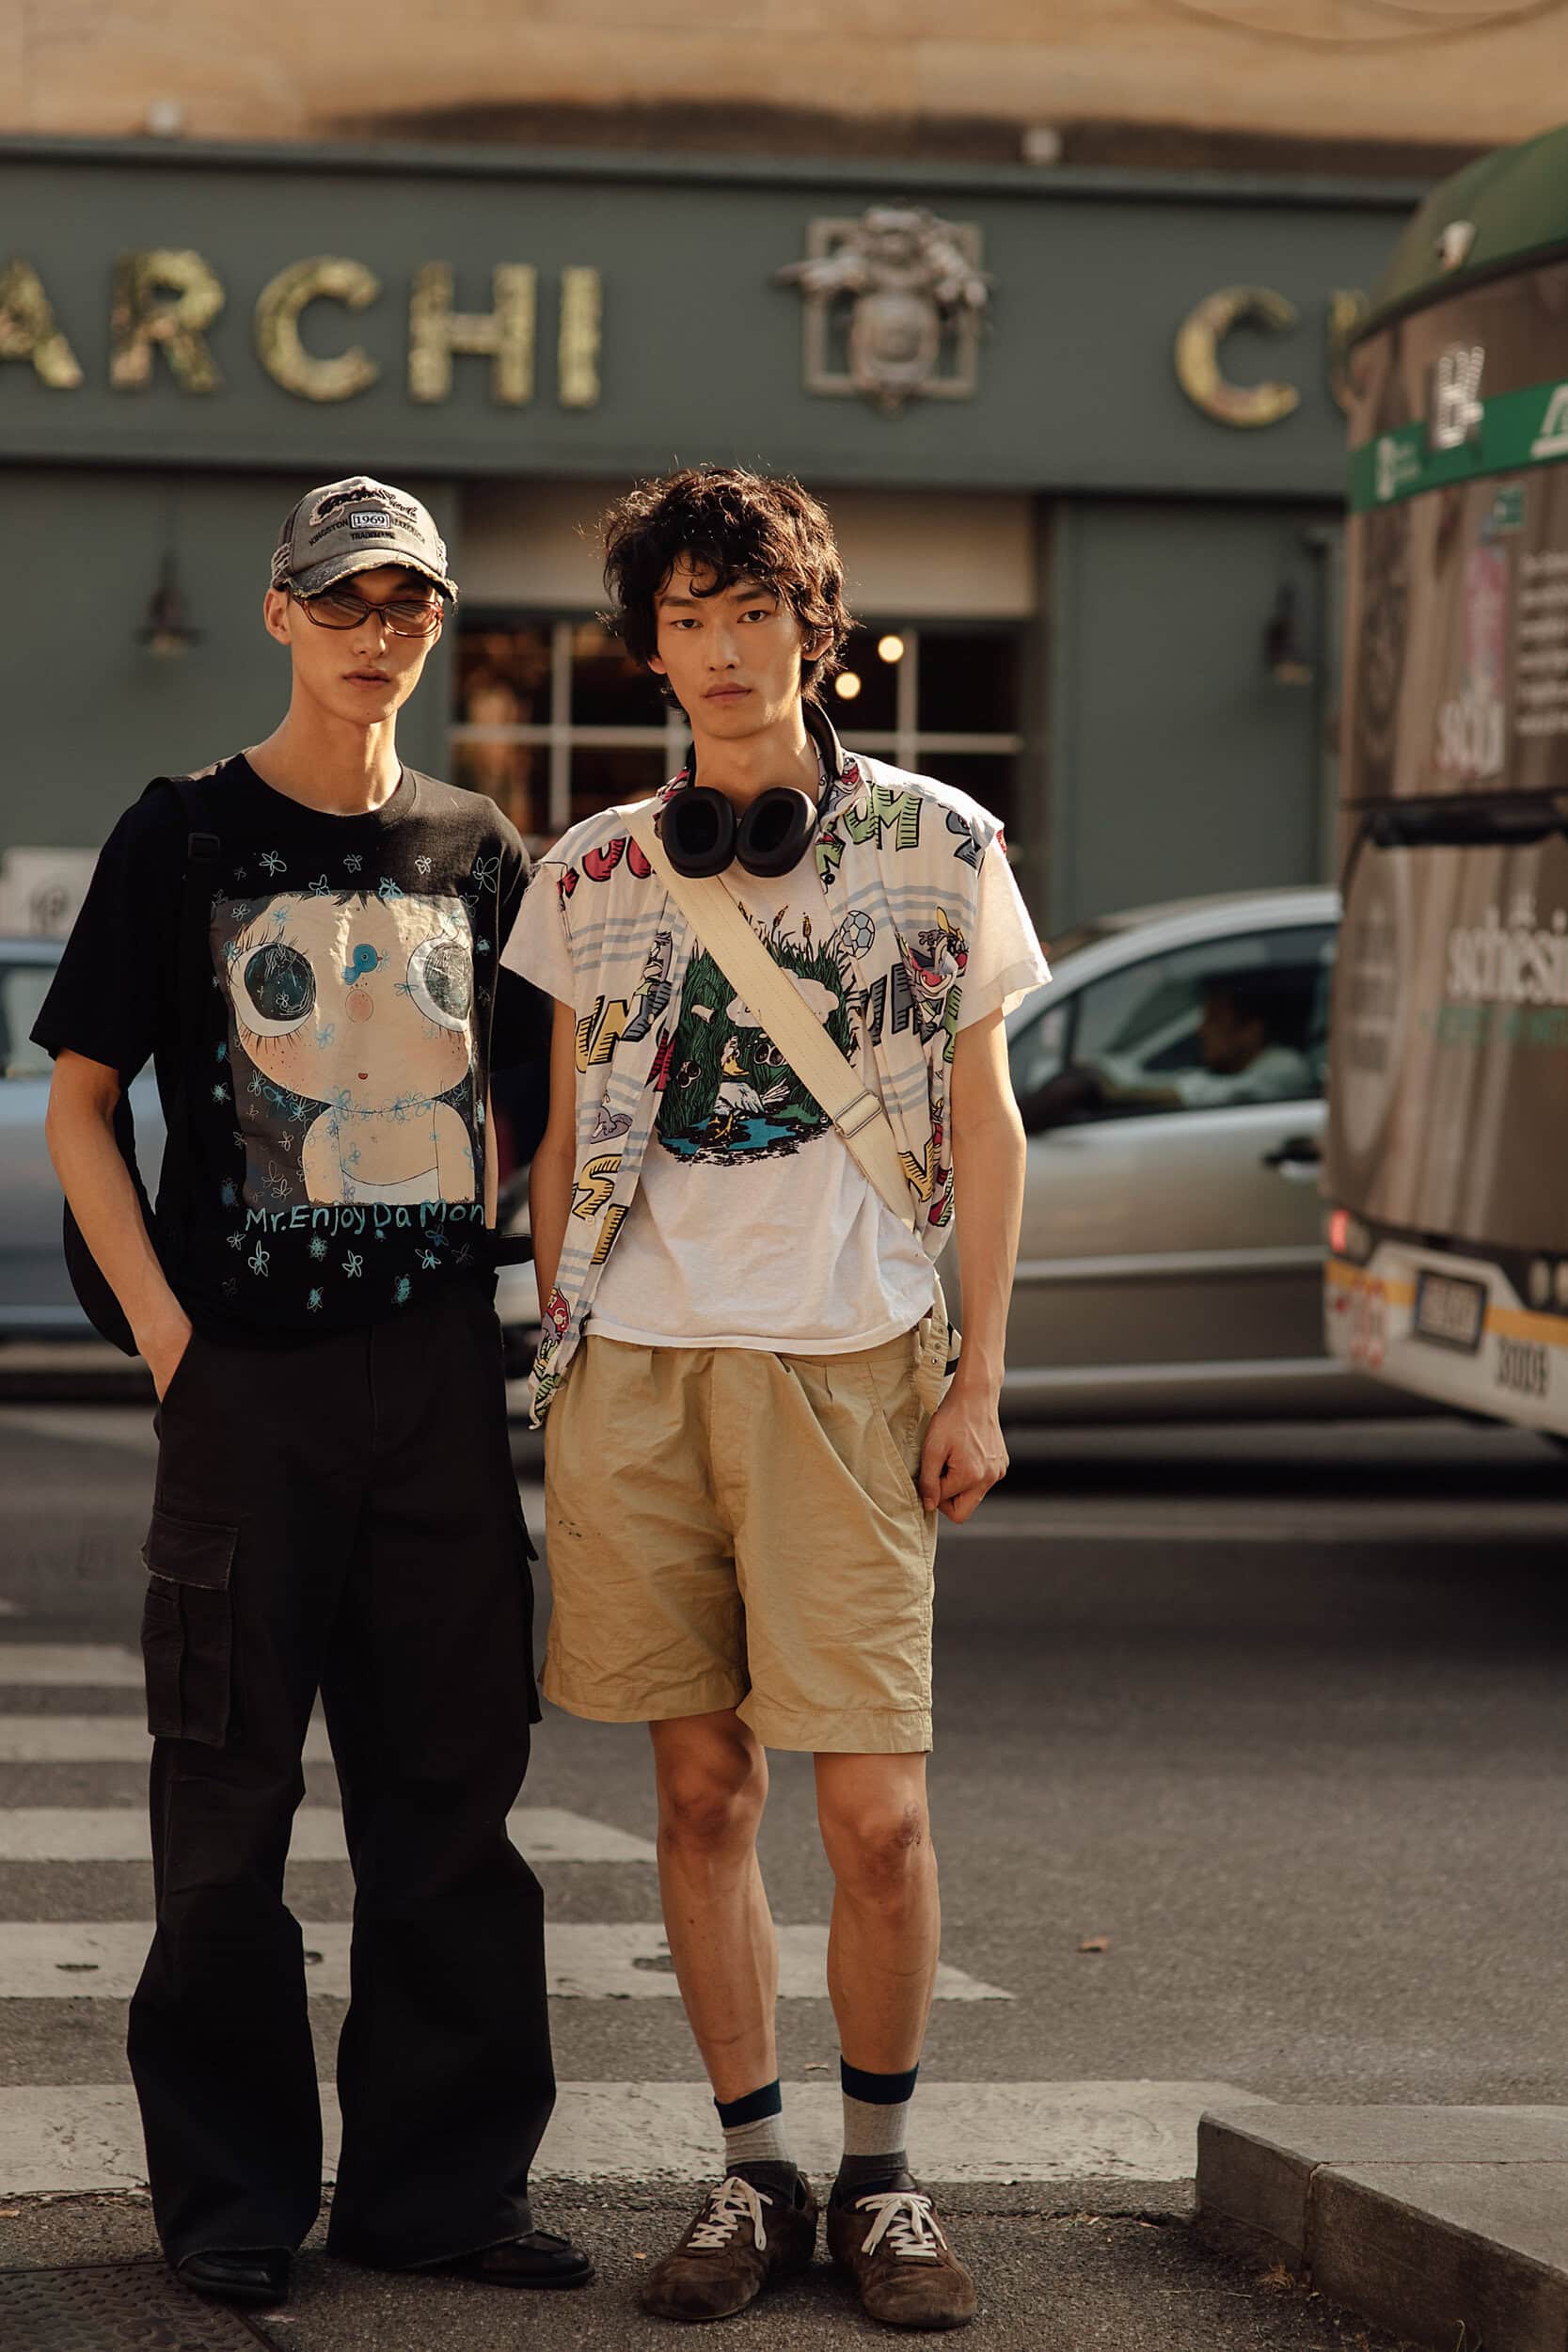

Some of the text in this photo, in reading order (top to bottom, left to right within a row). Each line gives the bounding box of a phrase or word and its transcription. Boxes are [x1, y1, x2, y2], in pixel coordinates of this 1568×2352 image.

[308, 518, 348, 547] KINGSTON
[356, 516, 386, 526] 1969
[373, 1200, 412, 1228] Da
[420, 1198, 484, 1227] Mon
